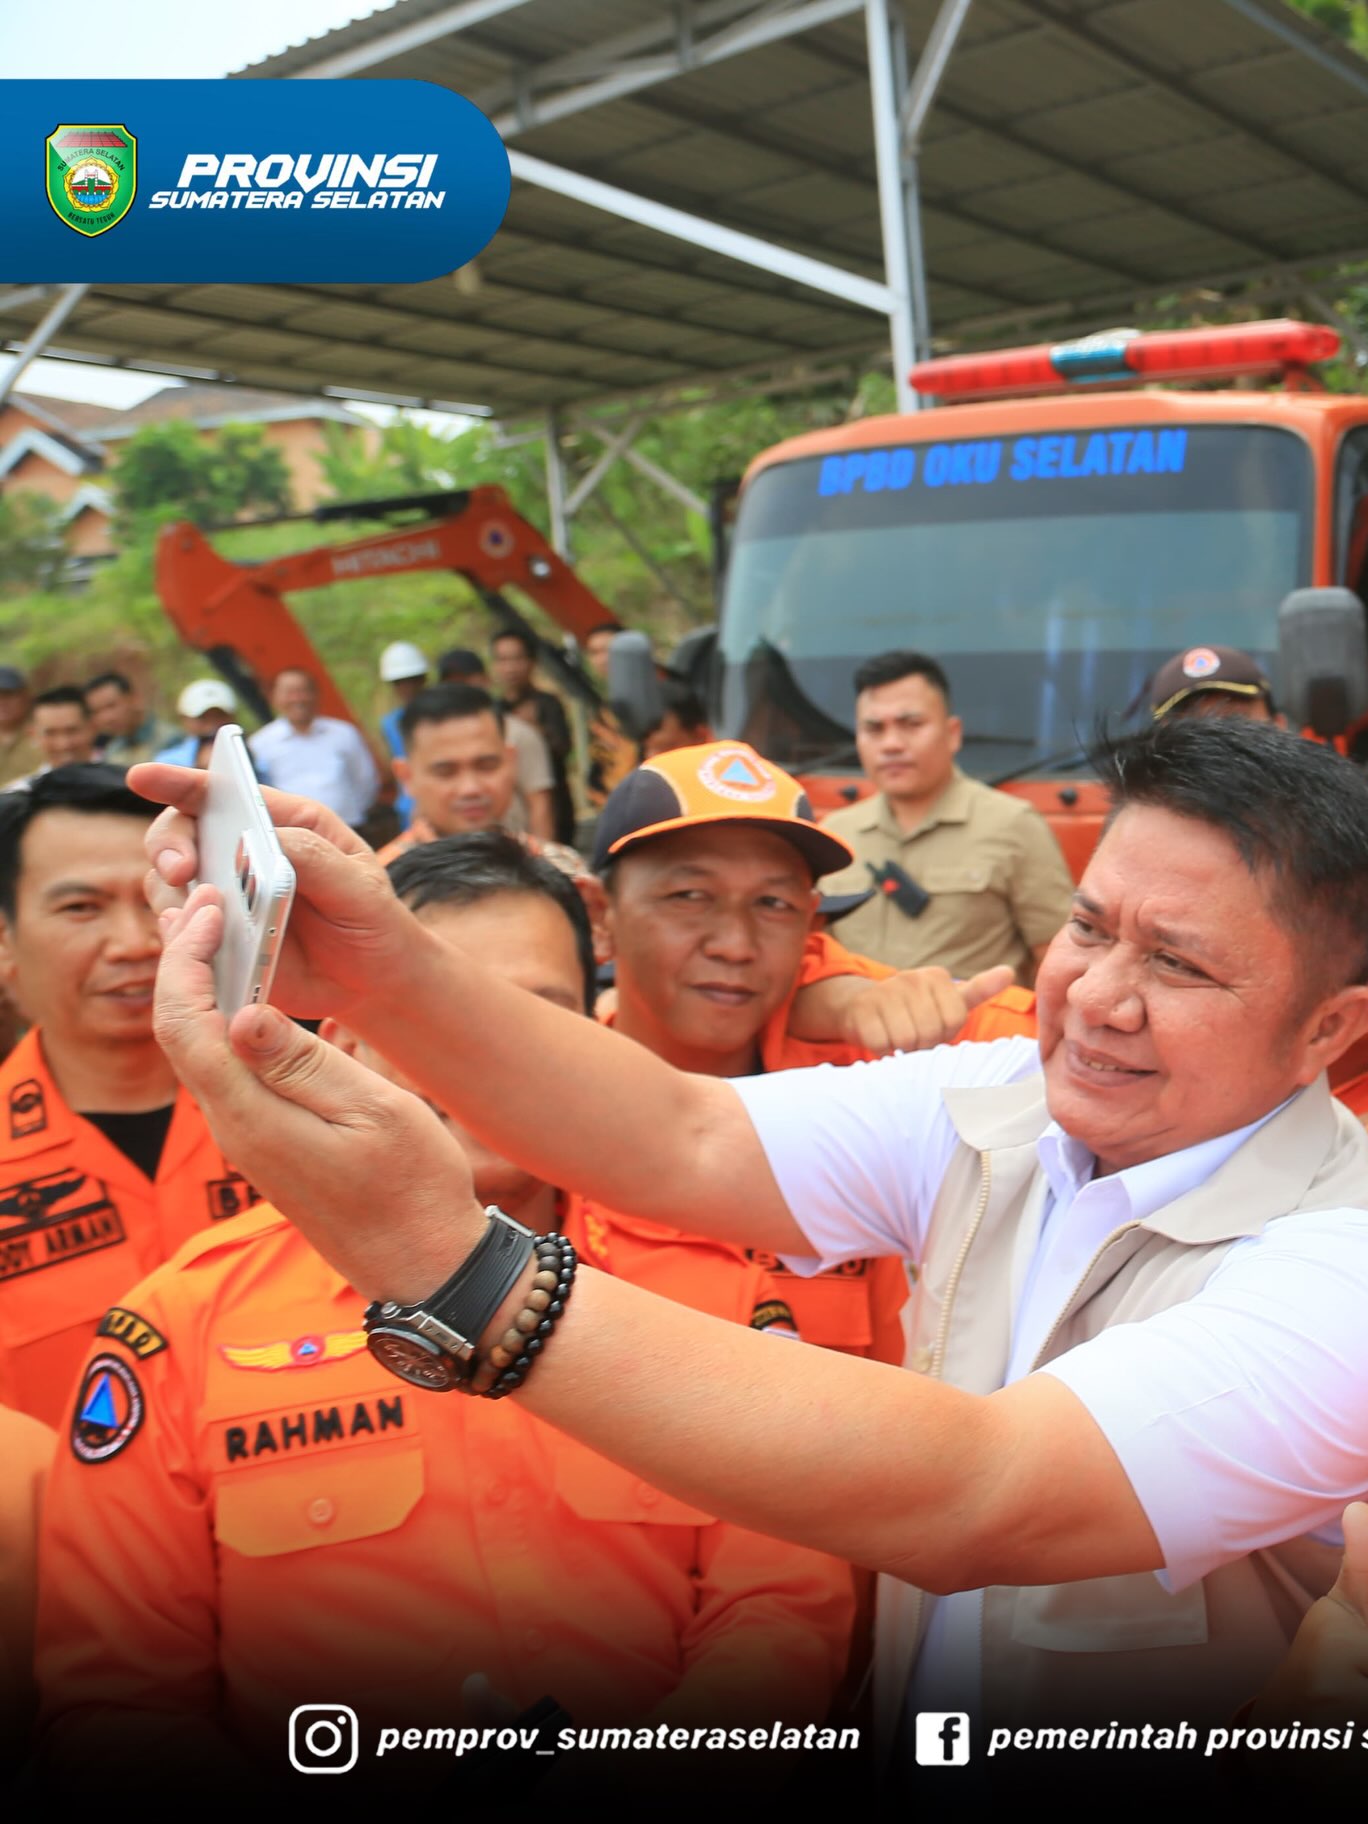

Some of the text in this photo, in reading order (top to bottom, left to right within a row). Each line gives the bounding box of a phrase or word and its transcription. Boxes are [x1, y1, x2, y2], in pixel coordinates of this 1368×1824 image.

[817, 428, 1188, 497] BPBD OKU SELATAN
[225, 1395, 405, 1464] RAHMAN
